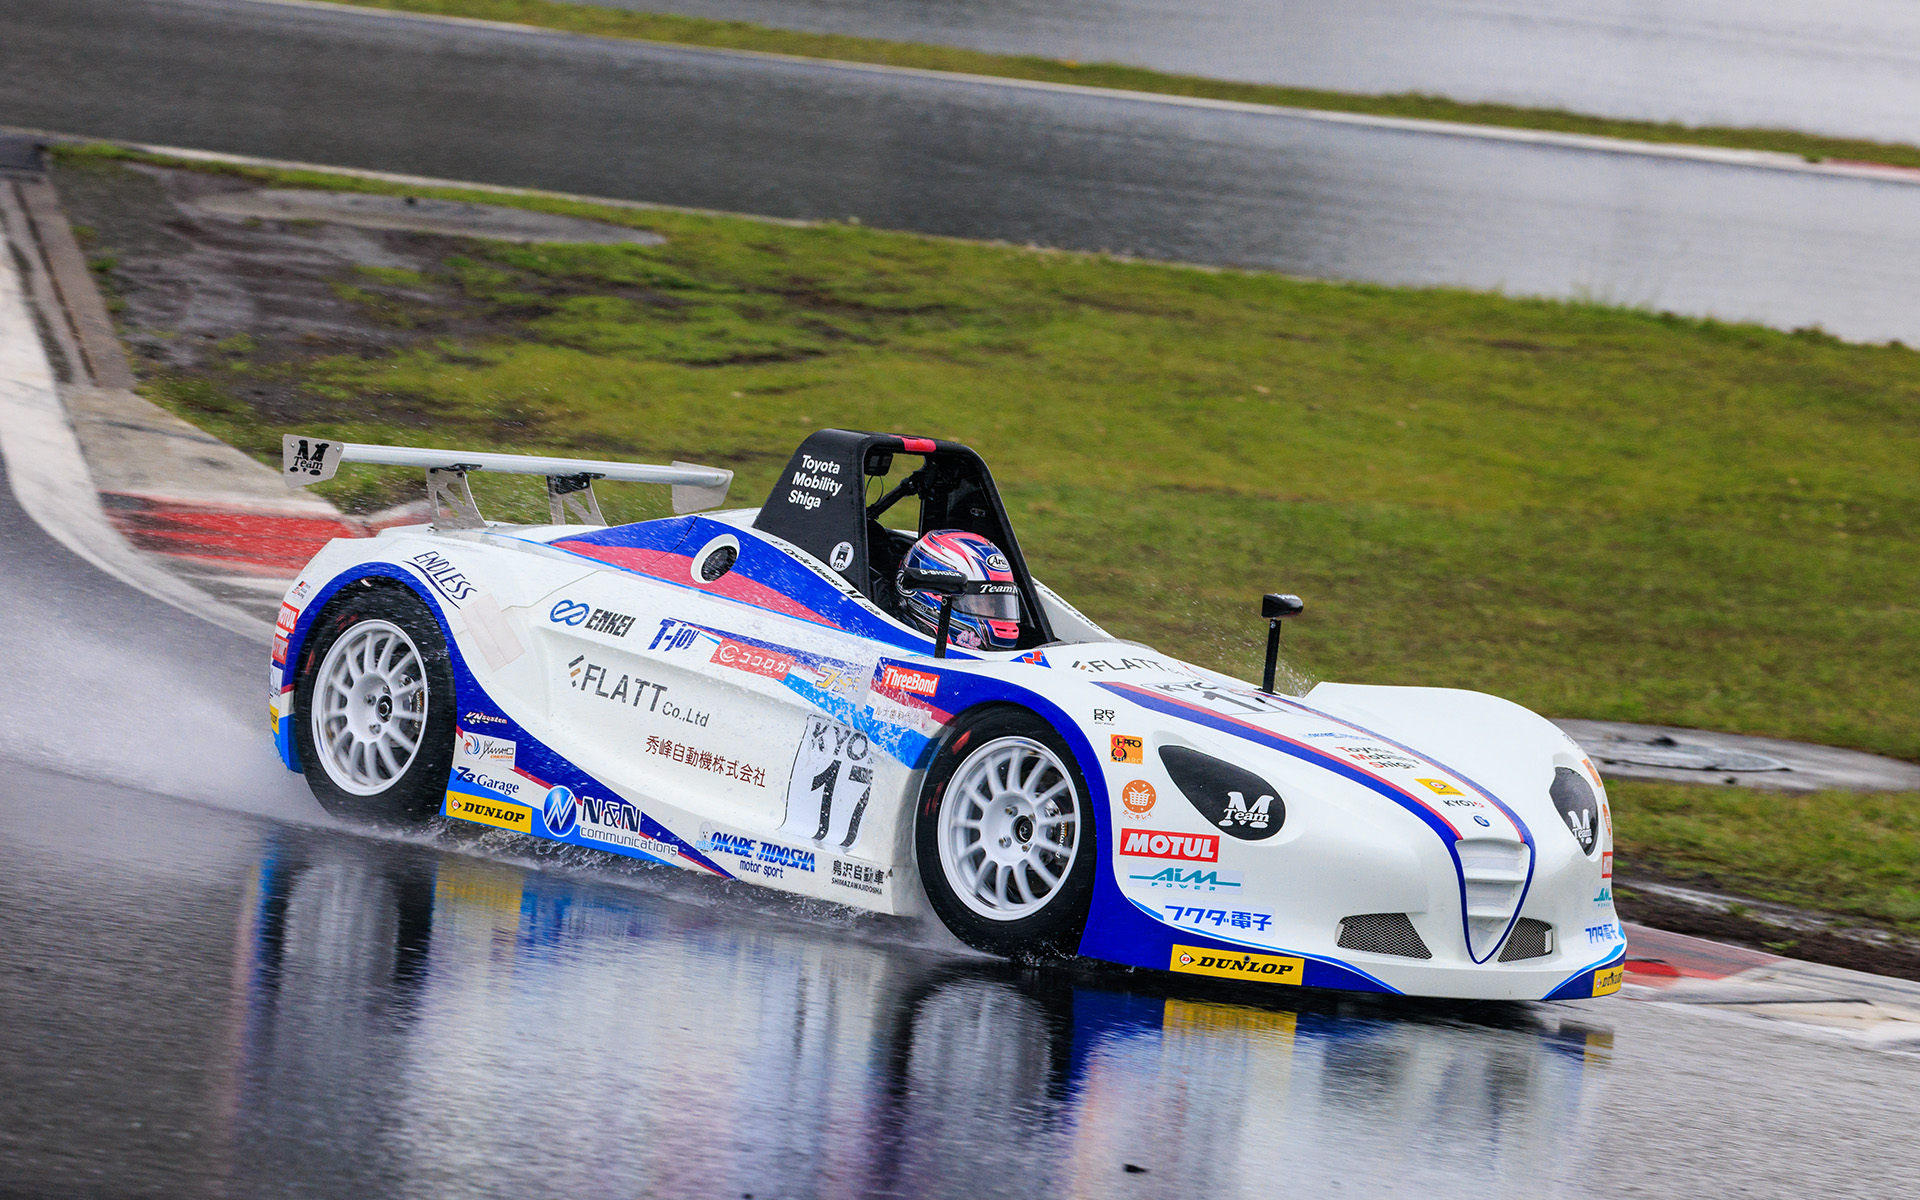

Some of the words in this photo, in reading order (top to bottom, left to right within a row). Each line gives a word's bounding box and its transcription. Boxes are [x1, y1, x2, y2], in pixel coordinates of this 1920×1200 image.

[294, 456, 323, 470] Team
[802, 454, 841, 475] Toyota
[792, 471, 843, 497] Mobility
[788, 489, 822, 510] Shiga
[413, 550, 478, 600] ENDLESS
[584, 608, 636, 638] ENKEI
[739, 652, 787, 673] ココロカ
[1088, 658, 1167, 672] FLATT
[885, 667, 938, 694] ThreeBond
[580, 663, 668, 712] FLATT
[662, 701, 710, 728] Co.,Ltd
[645, 735, 766, 788] 秀峰自動機株式会社
[455, 766, 476, 783] 73
[477, 773, 520, 795] Garage
[463, 802, 525, 823] DUNLOP
[581, 797, 640, 832] N&N
[810, 759, 874, 848] 17
[1218, 791, 1275, 829] M
[1223, 807, 1270, 823] Team
[580, 827, 678, 855] communications
[711, 832, 757, 858] OKABE
[1124, 832, 1215, 858] MOTUL
[739, 859, 761, 874] motor
[763, 865, 784, 879] sport
[1151, 882, 1216, 891] POWER
[1165, 905, 1272, 931] フクダ電子
[1197, 956, 1293, 975] DUNLOP
